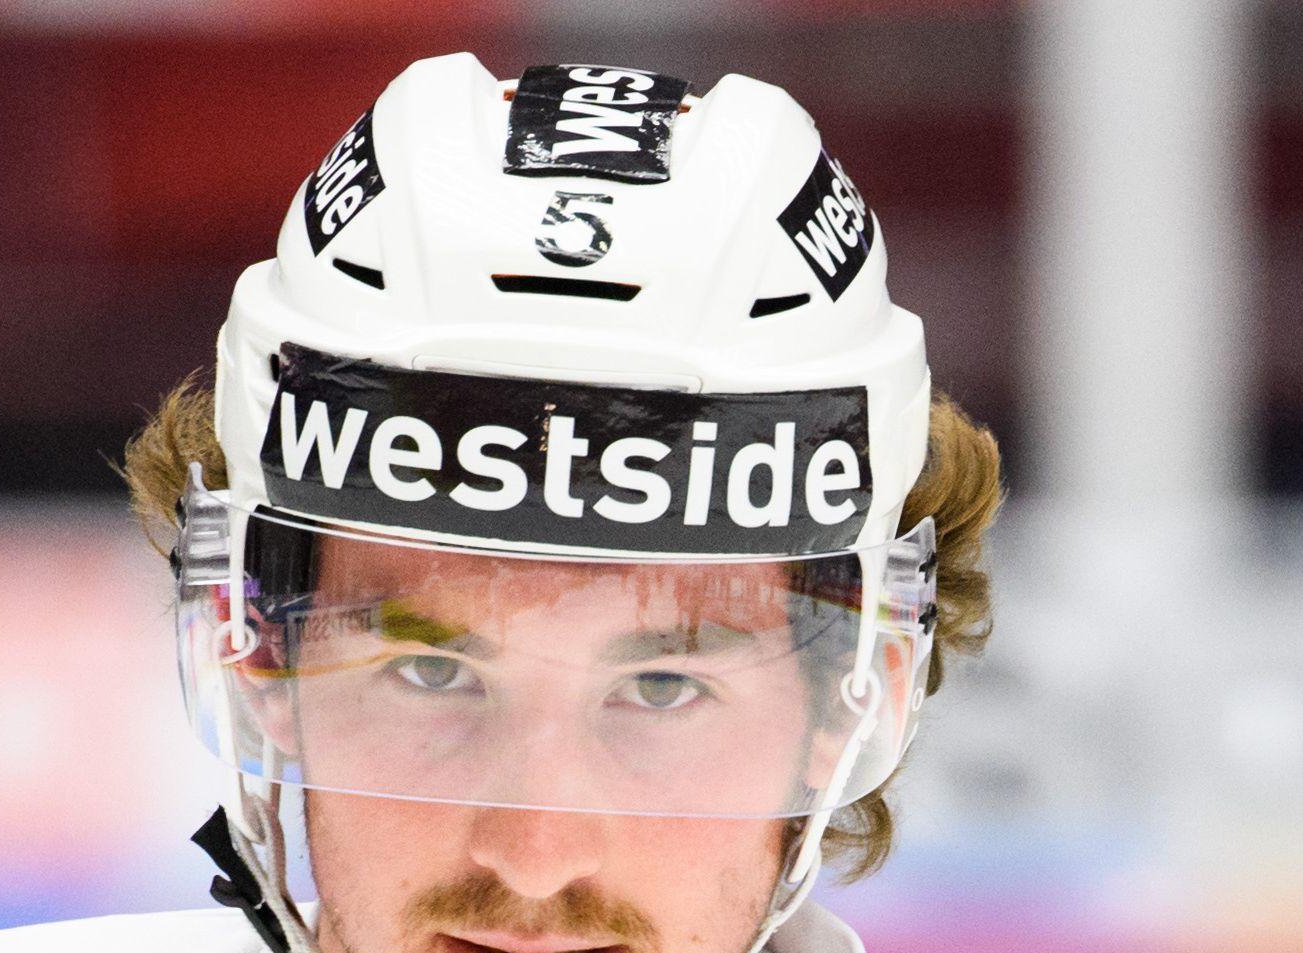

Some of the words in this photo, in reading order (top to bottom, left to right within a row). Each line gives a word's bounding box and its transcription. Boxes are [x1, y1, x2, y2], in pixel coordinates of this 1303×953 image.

[552, 65, 654, 160] wes
[315, 129, 368, 236] side
[534, 190, 614, 268] 5
[280, 391, 861, 529] westside
